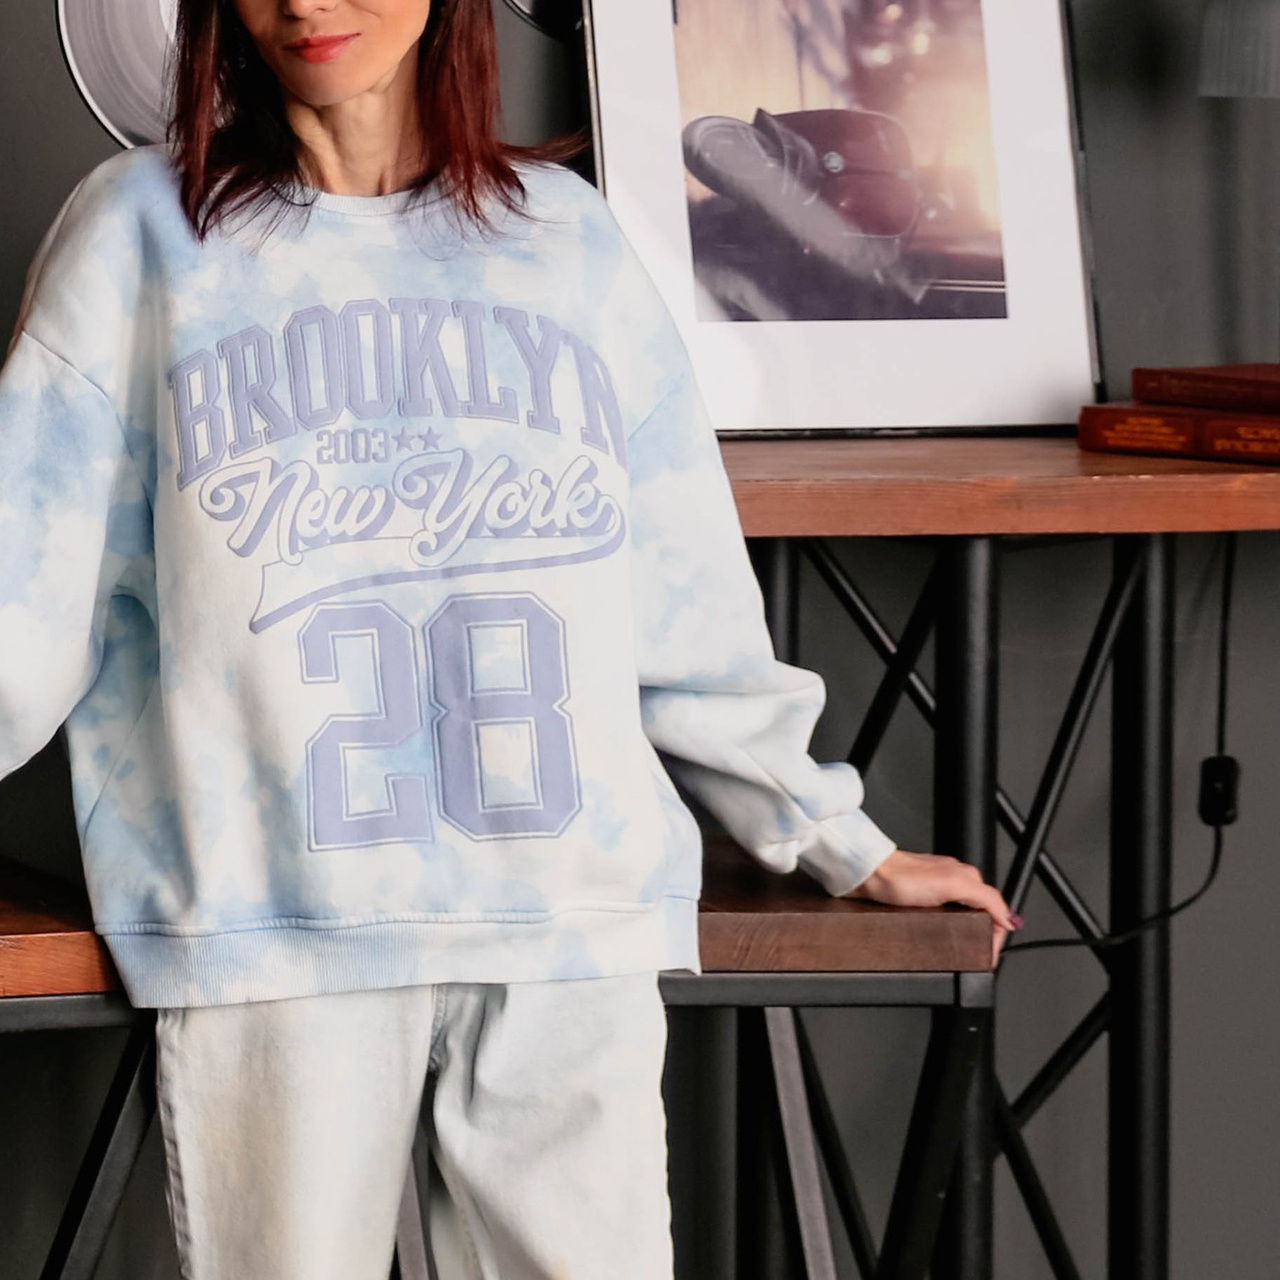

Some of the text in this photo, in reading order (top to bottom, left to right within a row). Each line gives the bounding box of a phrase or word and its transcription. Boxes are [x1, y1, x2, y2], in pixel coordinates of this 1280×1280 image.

[169, 299, 627, 489] BROOKLYN
[316, 427, 391, 465] 2003
[200, 449, 620, 567] New York
[300, 592, 582, 851] 28
